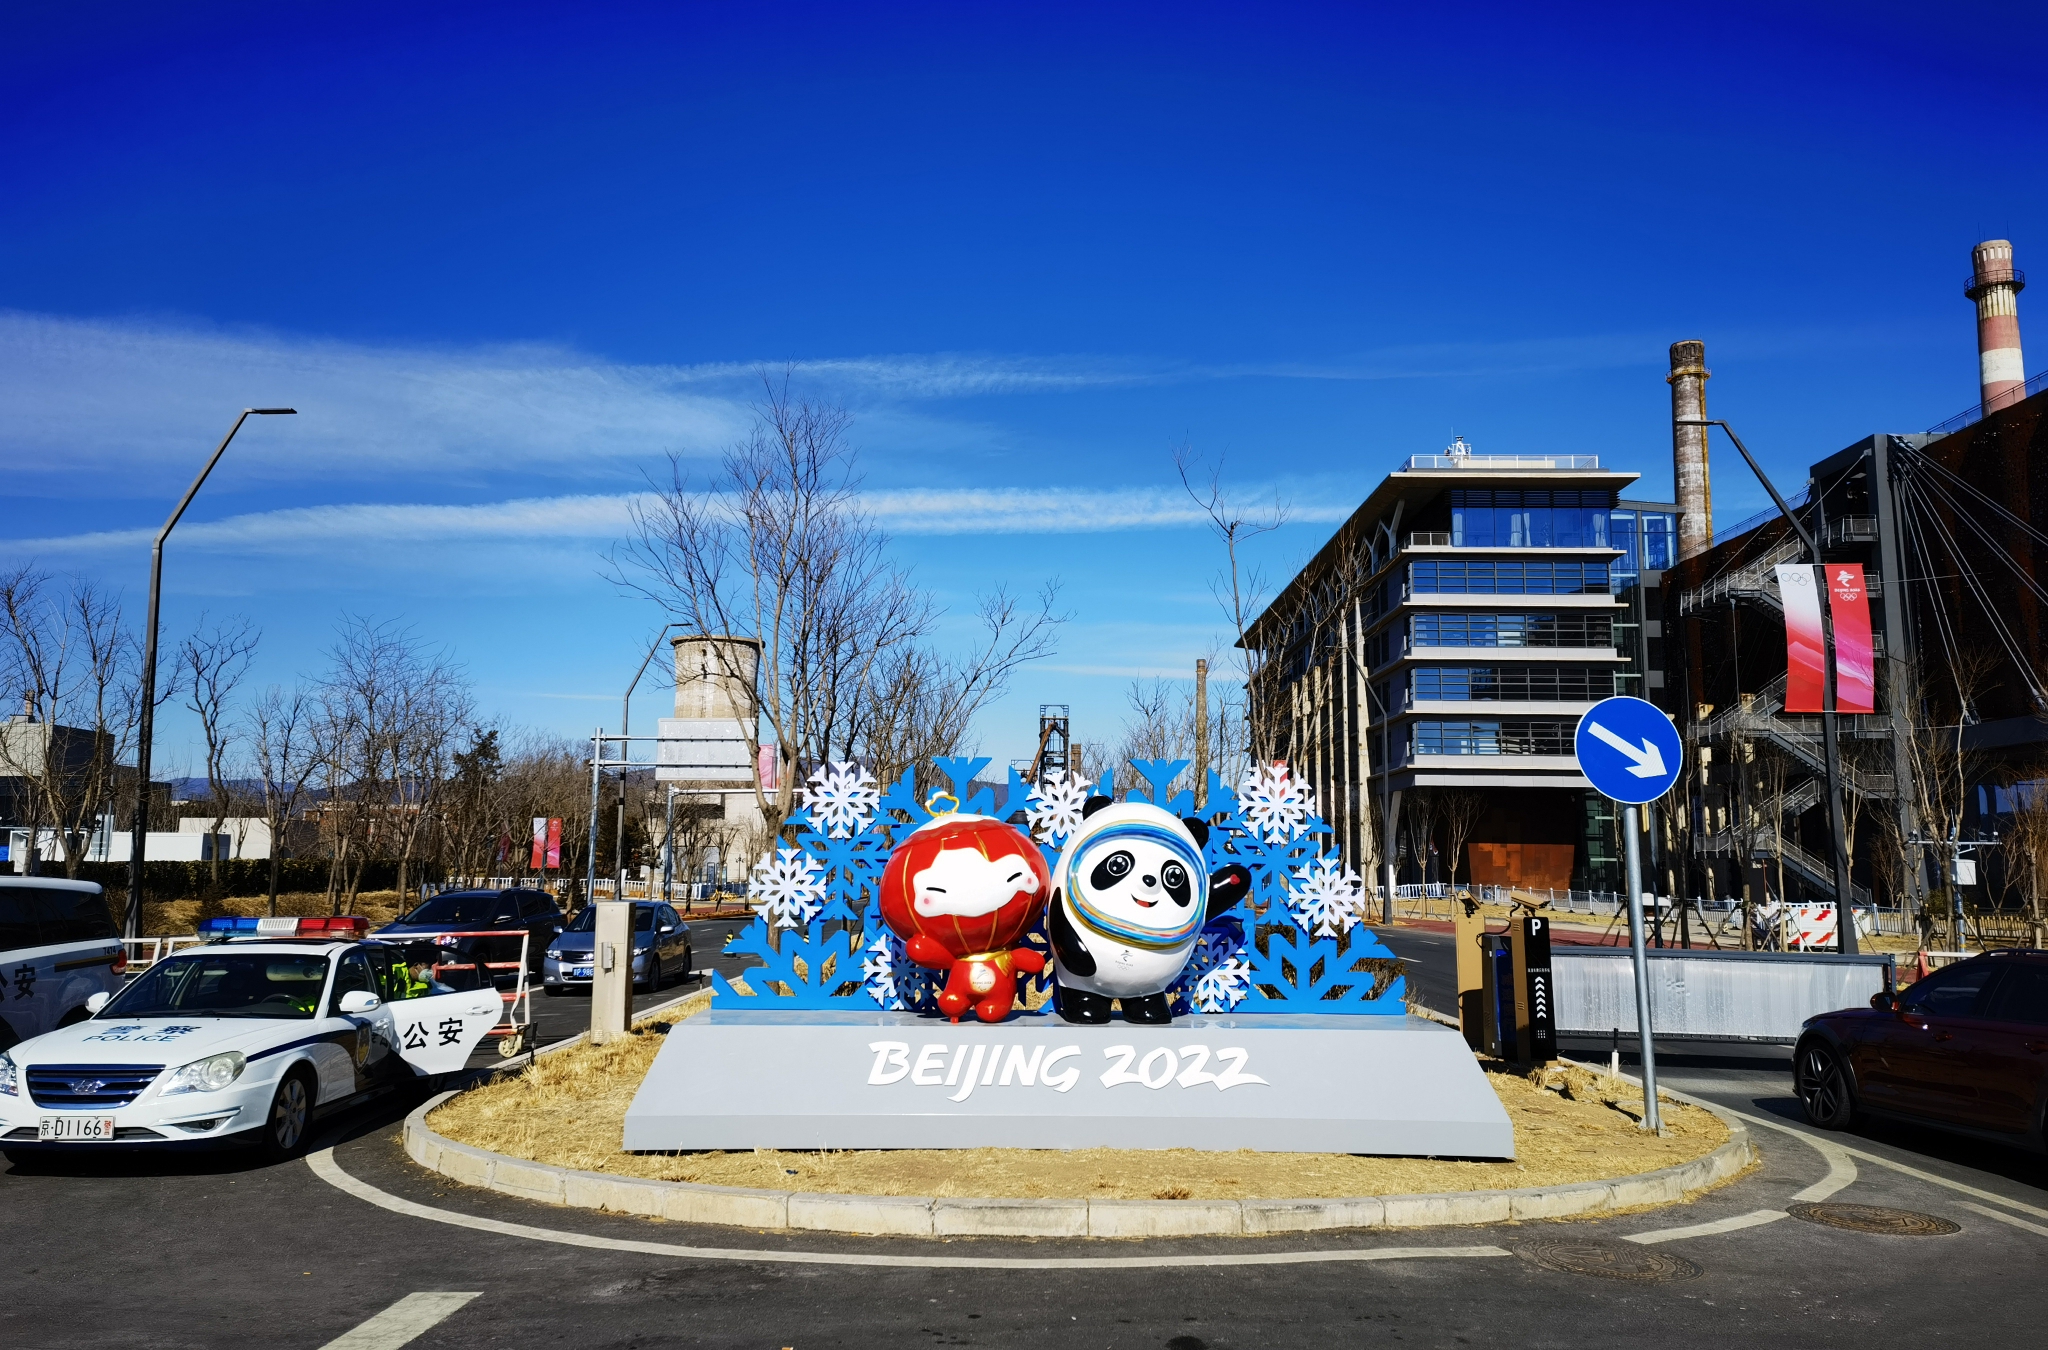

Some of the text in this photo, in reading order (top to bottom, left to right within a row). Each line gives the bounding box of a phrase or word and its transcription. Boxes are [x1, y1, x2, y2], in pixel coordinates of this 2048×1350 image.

[1531, 919, 1541, 936] P
[403, 1017, 463, 1050] 公安
[867, 1041, 1271, 1103] BEIJING 2022
